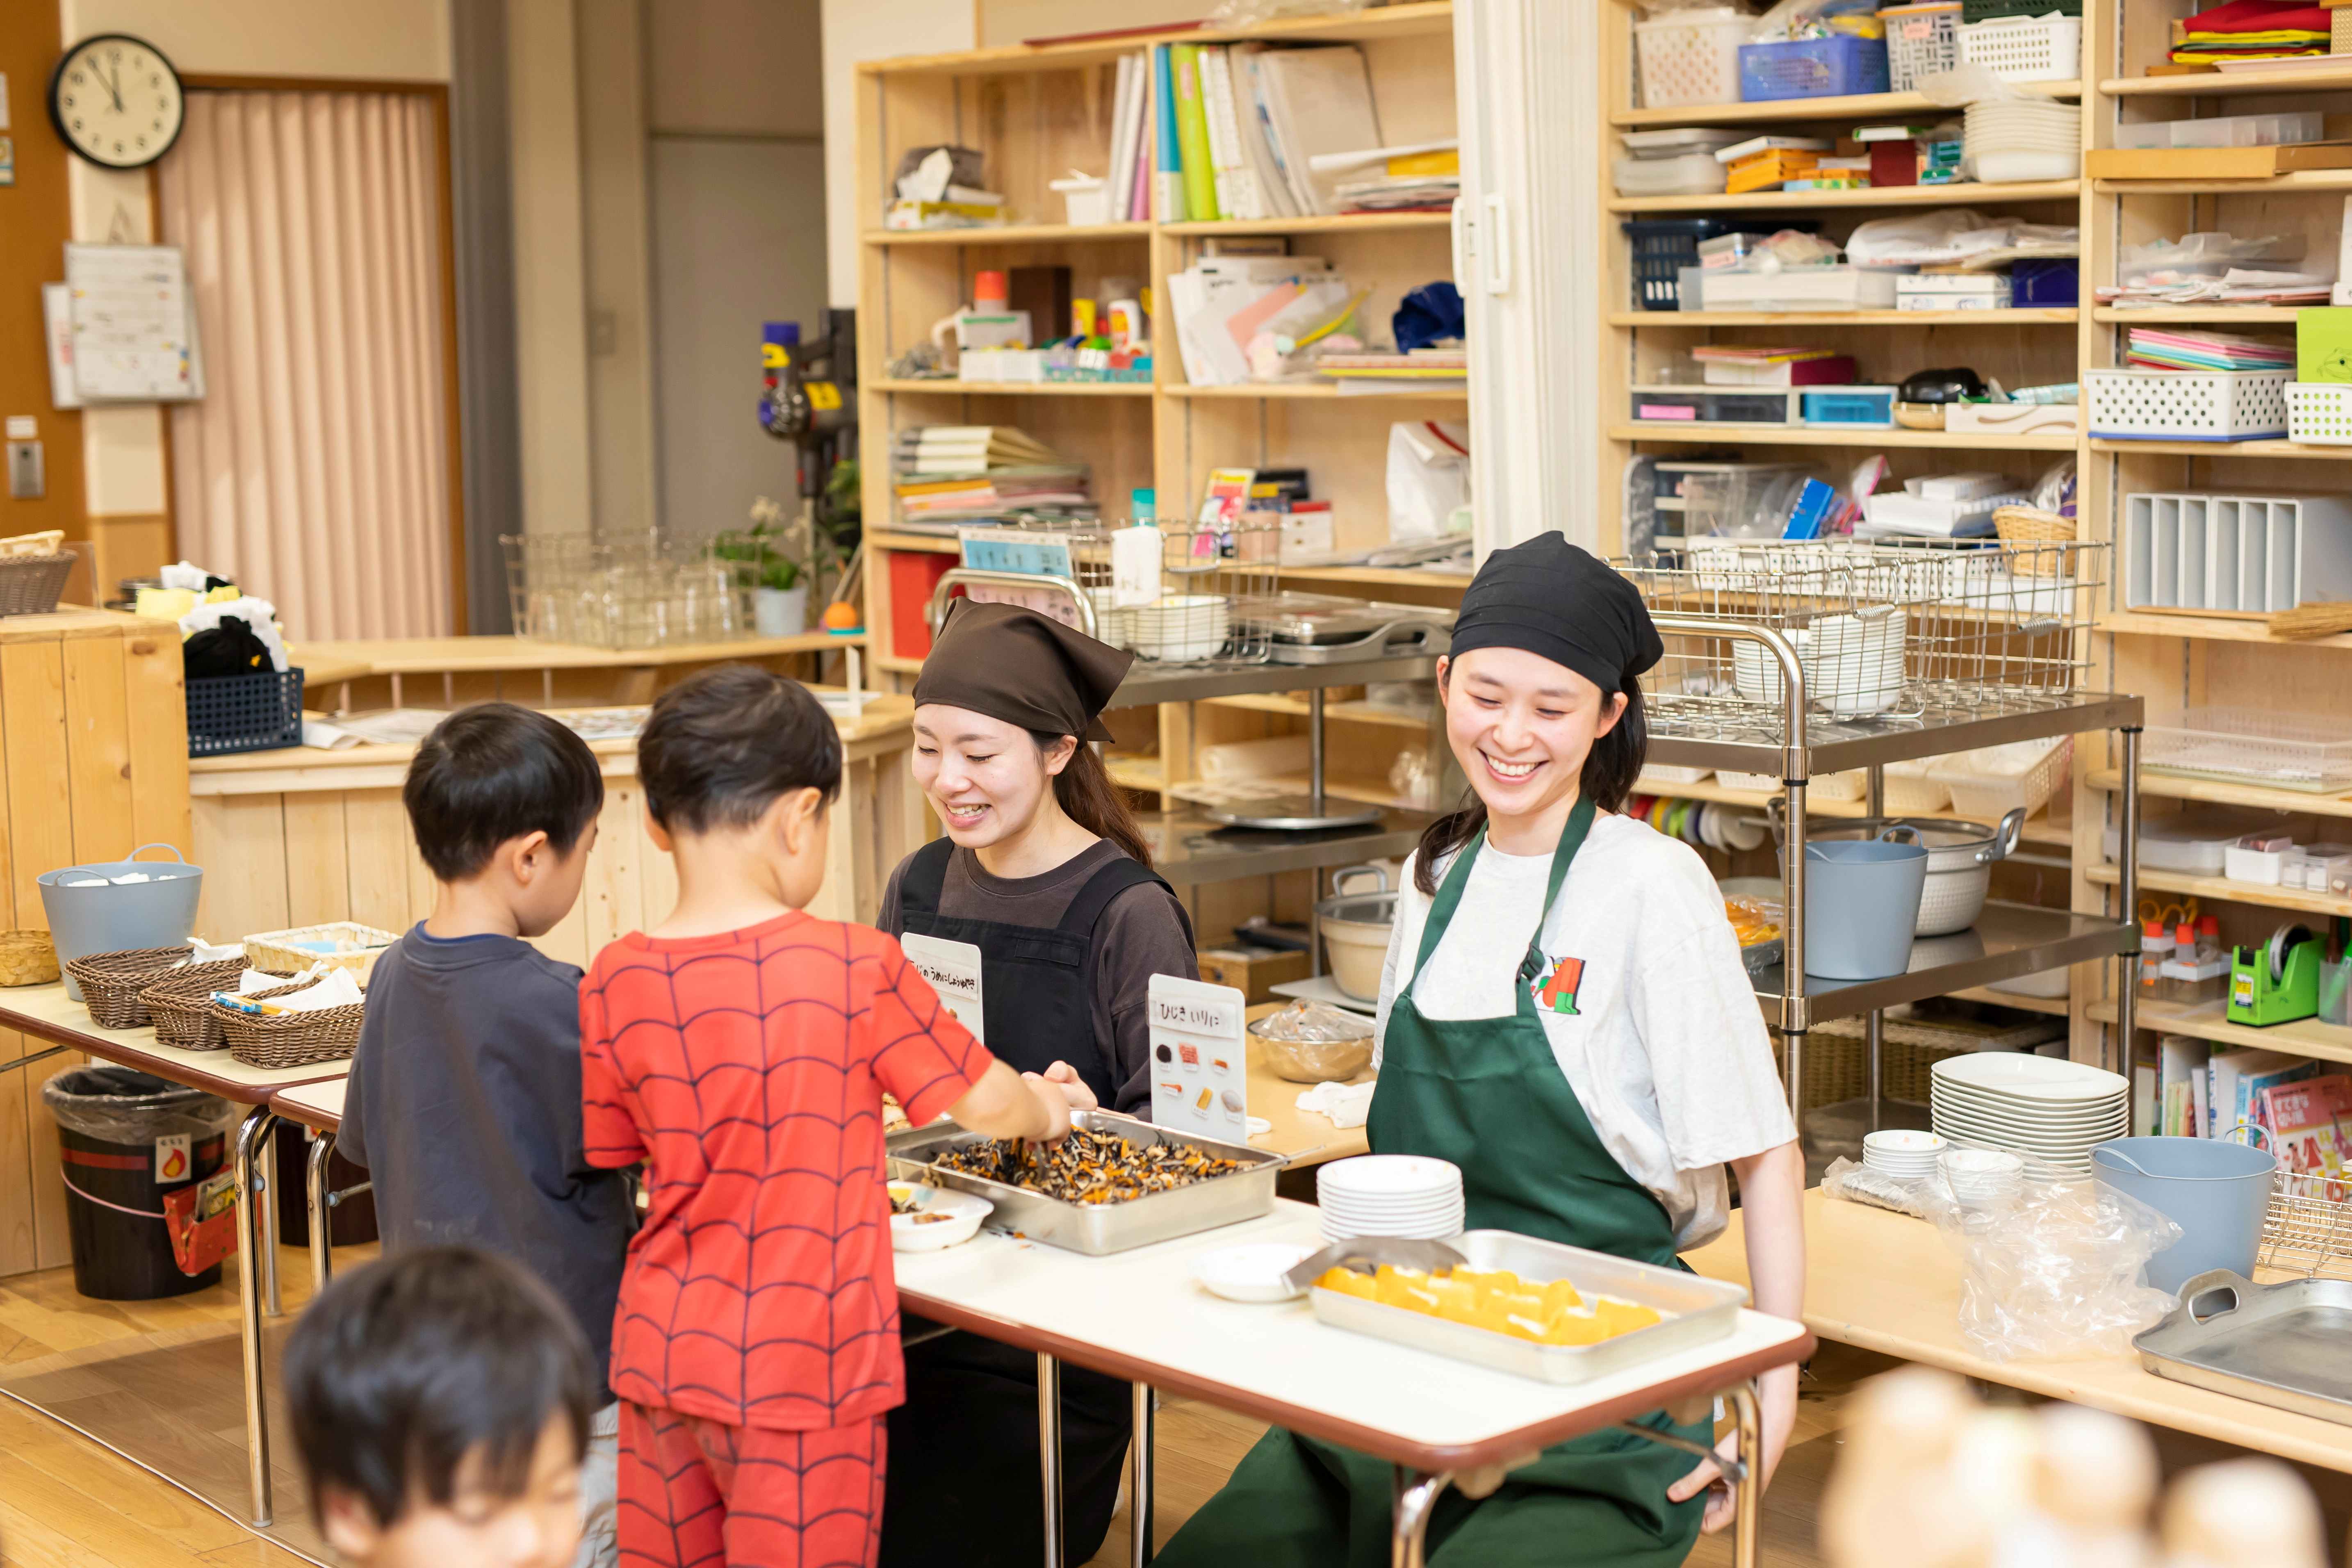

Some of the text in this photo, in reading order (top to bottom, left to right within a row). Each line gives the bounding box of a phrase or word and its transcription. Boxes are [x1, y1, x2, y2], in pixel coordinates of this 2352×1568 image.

[1160, 1003, 1219, 1027] ひじき いりに
